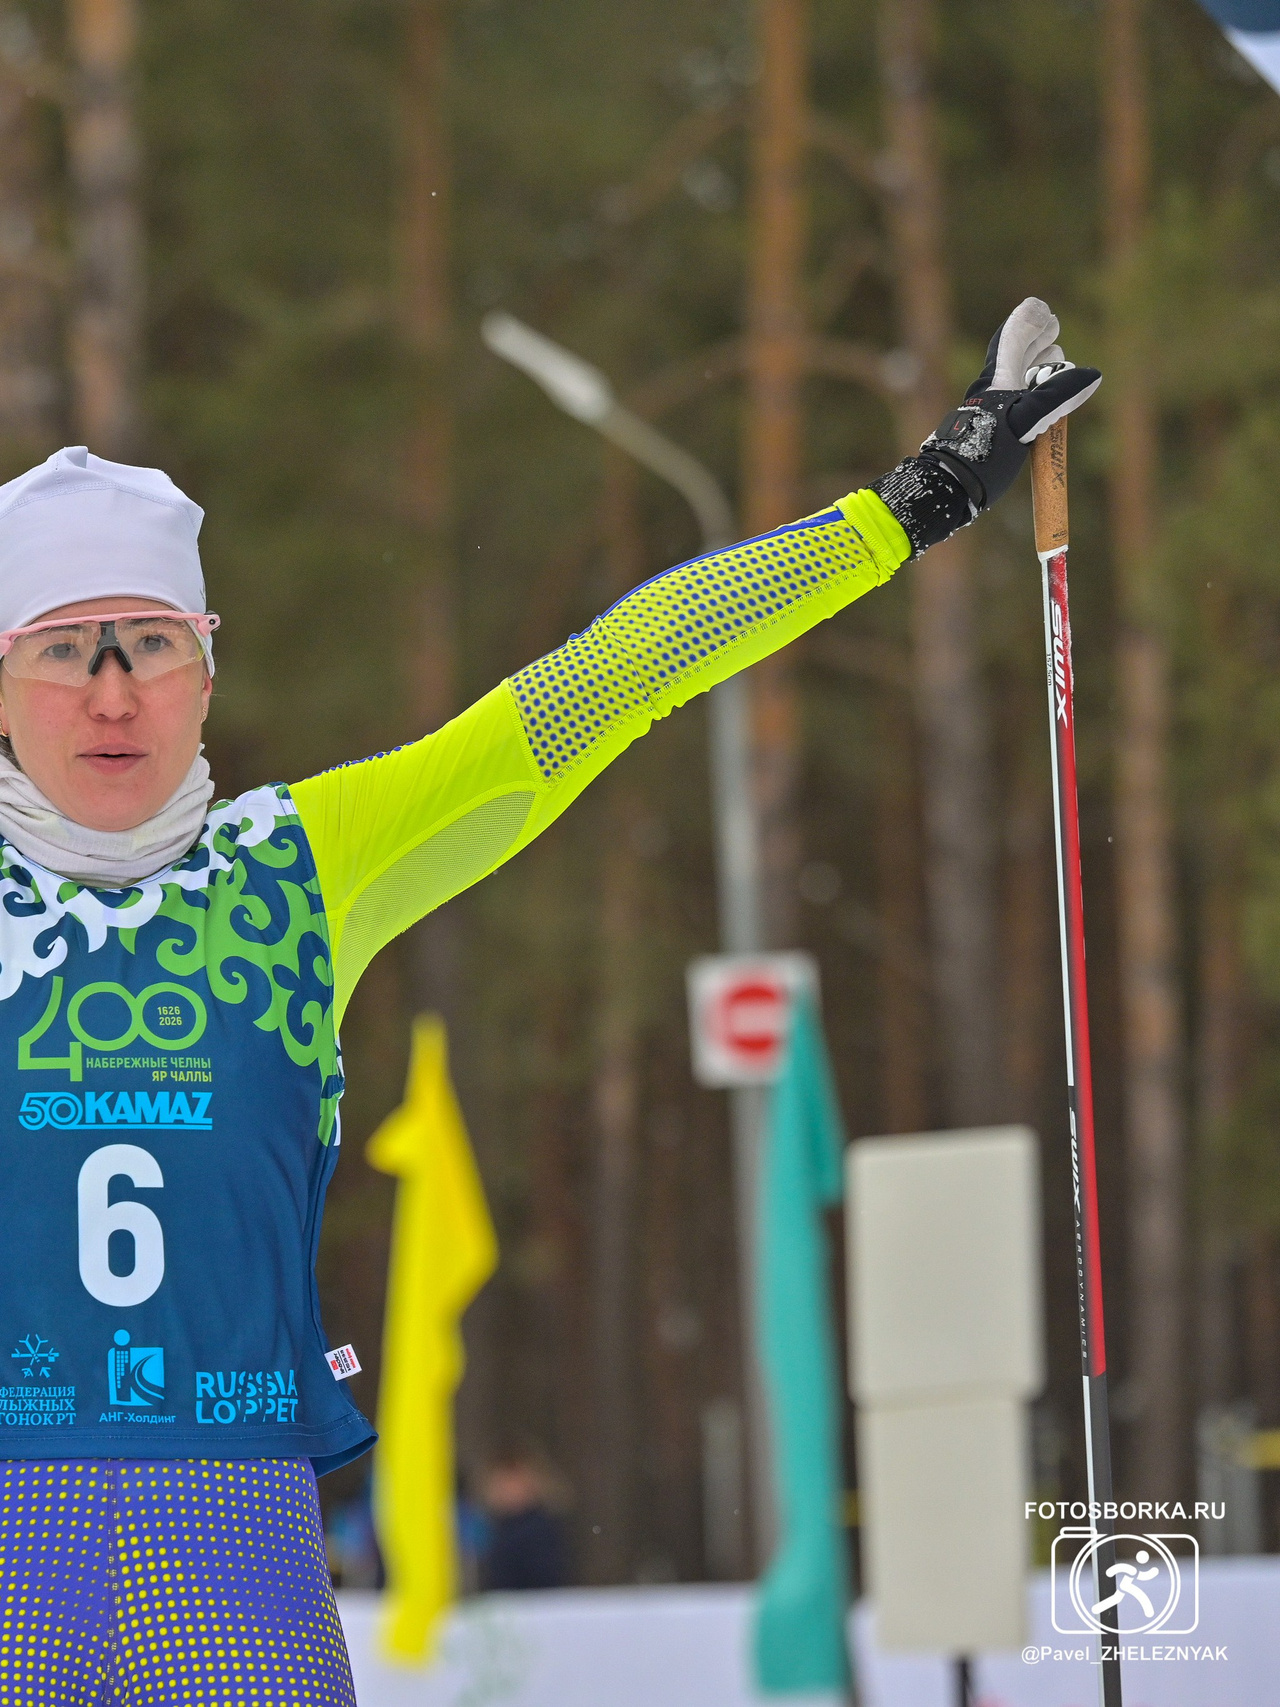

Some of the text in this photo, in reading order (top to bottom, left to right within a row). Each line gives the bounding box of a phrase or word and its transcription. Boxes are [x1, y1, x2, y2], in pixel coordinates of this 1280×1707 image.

[965, 398, 983, 406] LEFT
[953, 421, 960, 430] L
[1051, 599, 1068, 729] SWIX
[157, 1006, 181, 1016] 1626
[159, 1016, 182, 1026] 2026
[18, 976, 207, 1082] 400
[86, 1057, 211, 1069] НАБЕРЕЖНЫЕ ЧЕЛНЫ
[152, 1071, 212, 1083] ЯР ЧАЛЛЫ
[77, 1143, 165, 1307] 6
[195, 1369, 299, 1399] RUSSIA
[195, 1398, 299, 1425] LOPPET
[56, 1412, 77, 1425] РТ
[99, 1412, 176, 1425] АНГ-Холдинг
